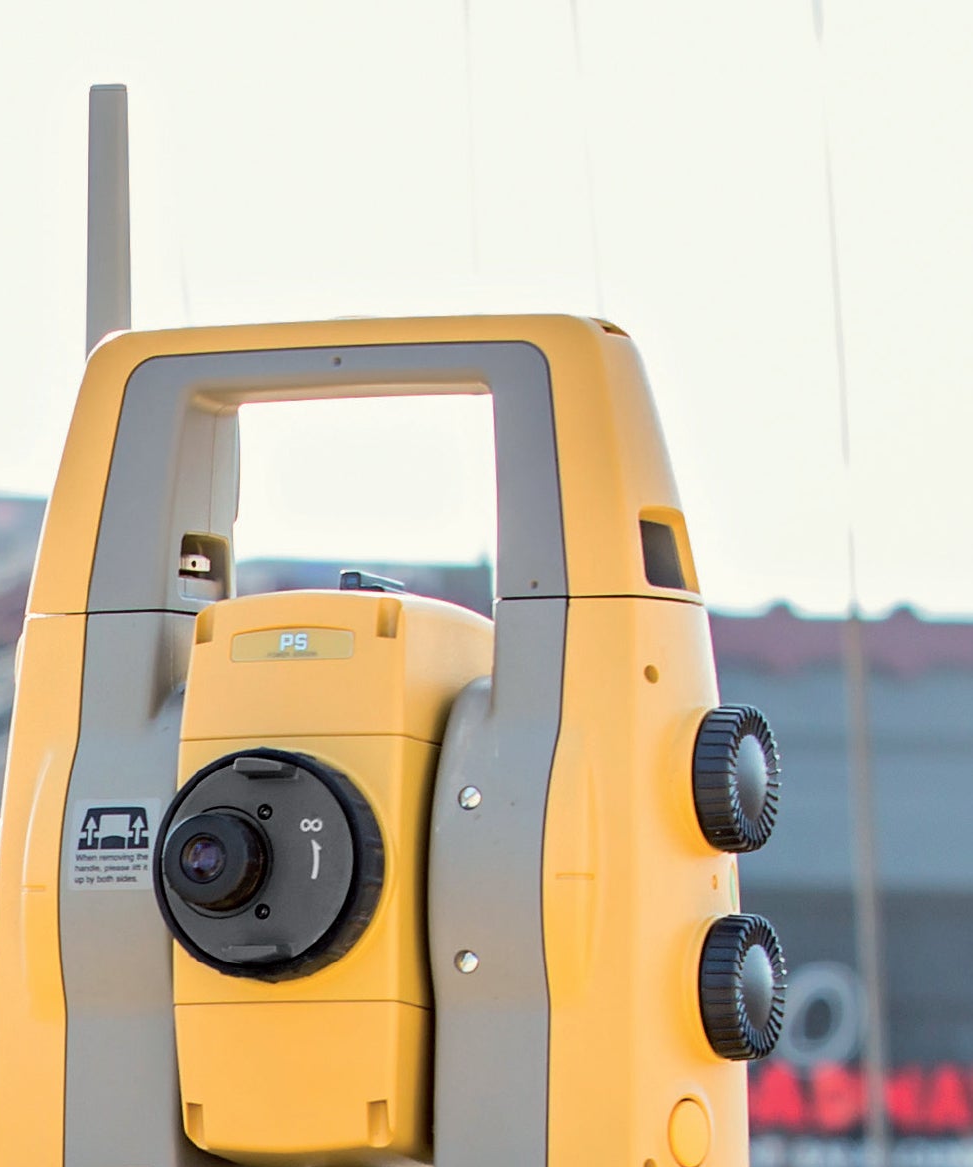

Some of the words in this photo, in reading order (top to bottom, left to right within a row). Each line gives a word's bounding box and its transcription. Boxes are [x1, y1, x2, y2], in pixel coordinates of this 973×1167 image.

[280, 633, 307, 651] PS
[99, 854, 134, 863] removing
[86, 876, 95, 884] by
[96, 875, 114, 883] both
